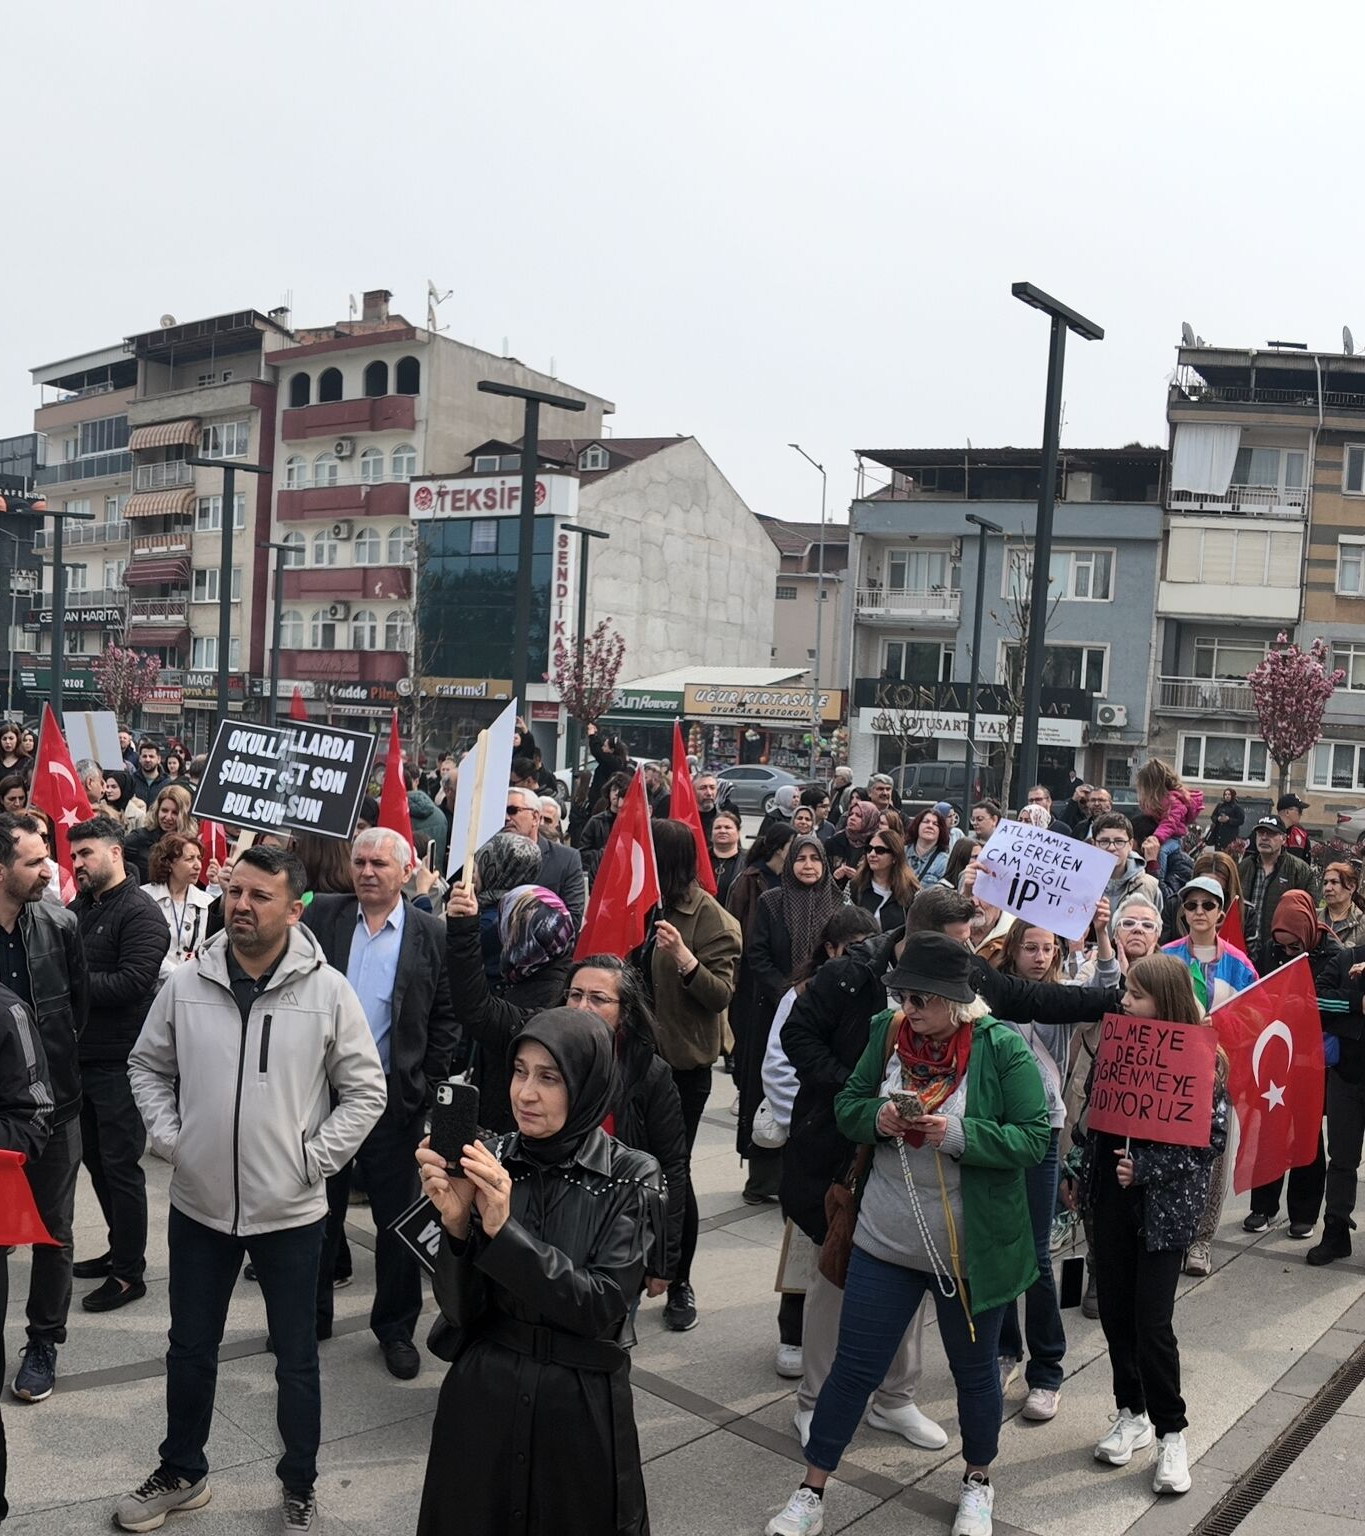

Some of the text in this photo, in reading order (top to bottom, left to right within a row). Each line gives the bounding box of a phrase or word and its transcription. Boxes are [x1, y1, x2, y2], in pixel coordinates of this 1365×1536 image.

[438, 481, 520, 512] TEKSİF
[39, 609, 121, 623] CEAN HARİTA
[435, 681, 487, 697] caramel
[695, 686, 831, 708] UĞUR KIRTASİYE
[874, 683, 985, 711] KONAK
[999, 824, 1072, 852] ATLAMAMIZ
[986, 848, 1072, 892] CAM DEĞİL
[1011, 840, 1083, 873] GEREKEN
[1116, 1044, 1168, 1070] DEĞİL
